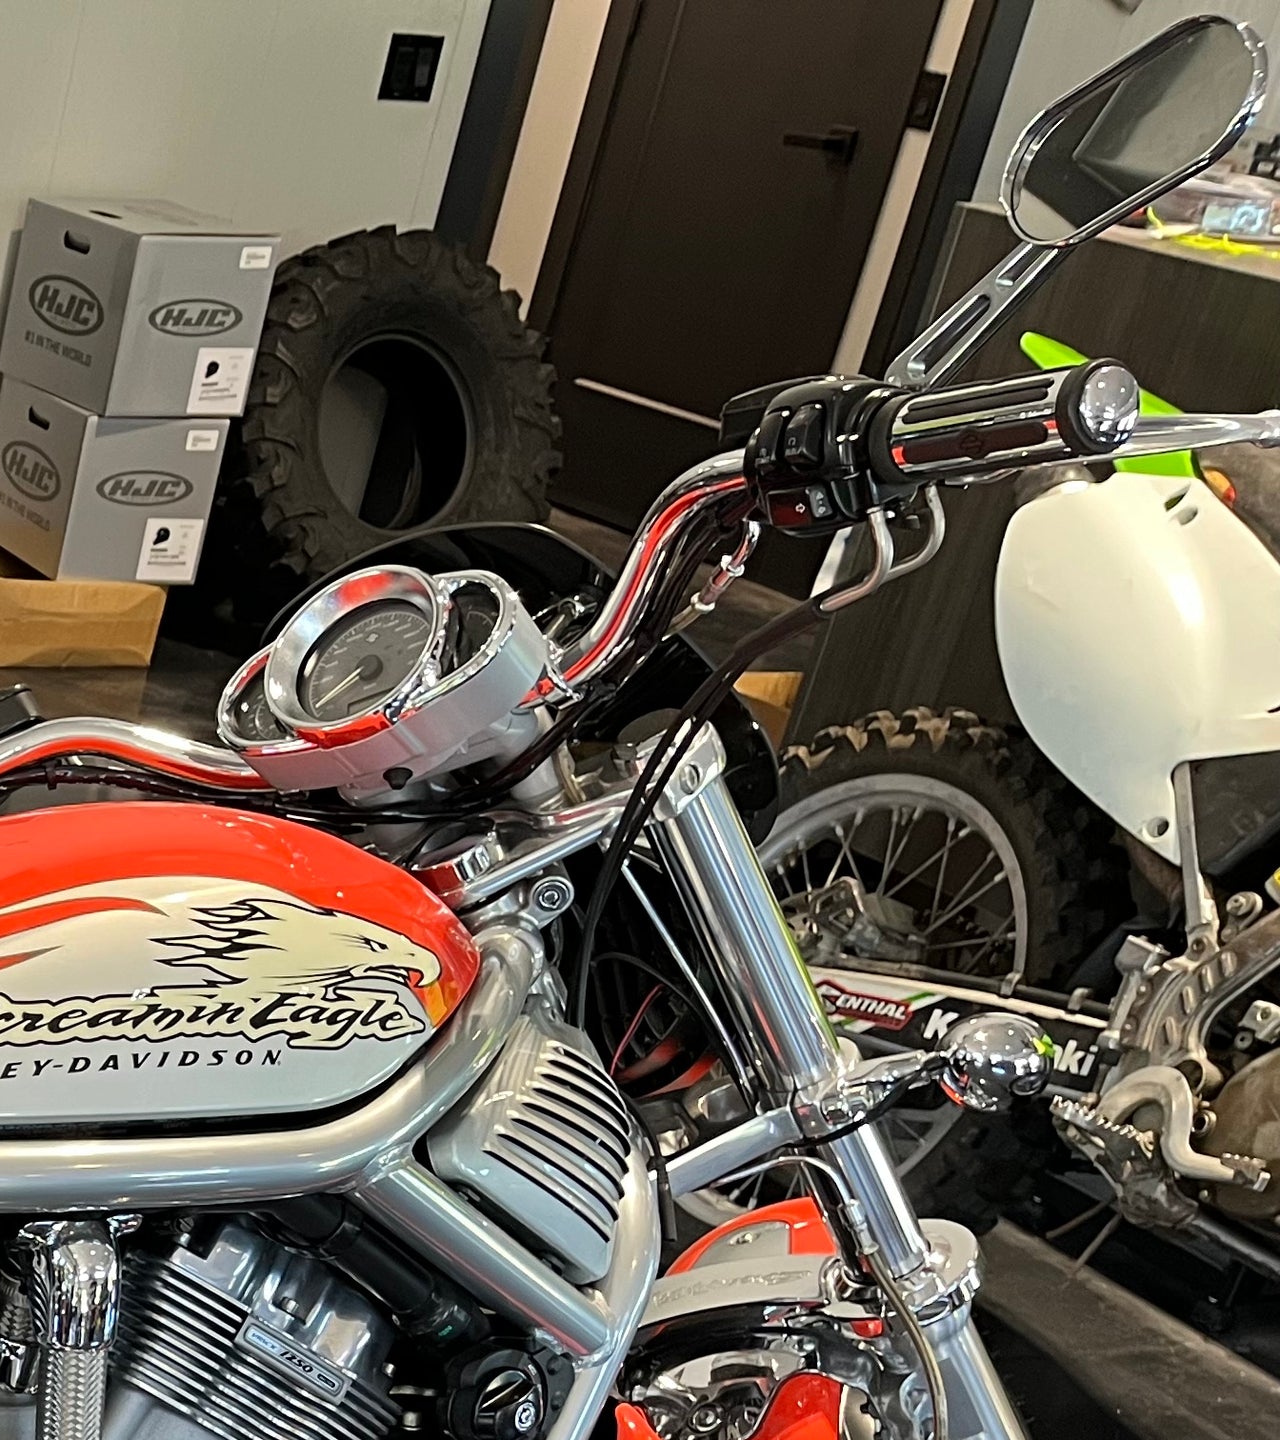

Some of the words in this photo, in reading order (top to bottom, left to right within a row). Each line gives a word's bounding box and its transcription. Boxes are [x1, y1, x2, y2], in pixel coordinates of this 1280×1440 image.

[37, 284, 95, 327] HJC
[160, 308, 231, 328] HJC
[5, 450, 55, 494] HJC
[107, 479, 182, 498] HJC
[248, 992, 420, 1047] Eagle
[280, 1350, 314, 1373] 1250
